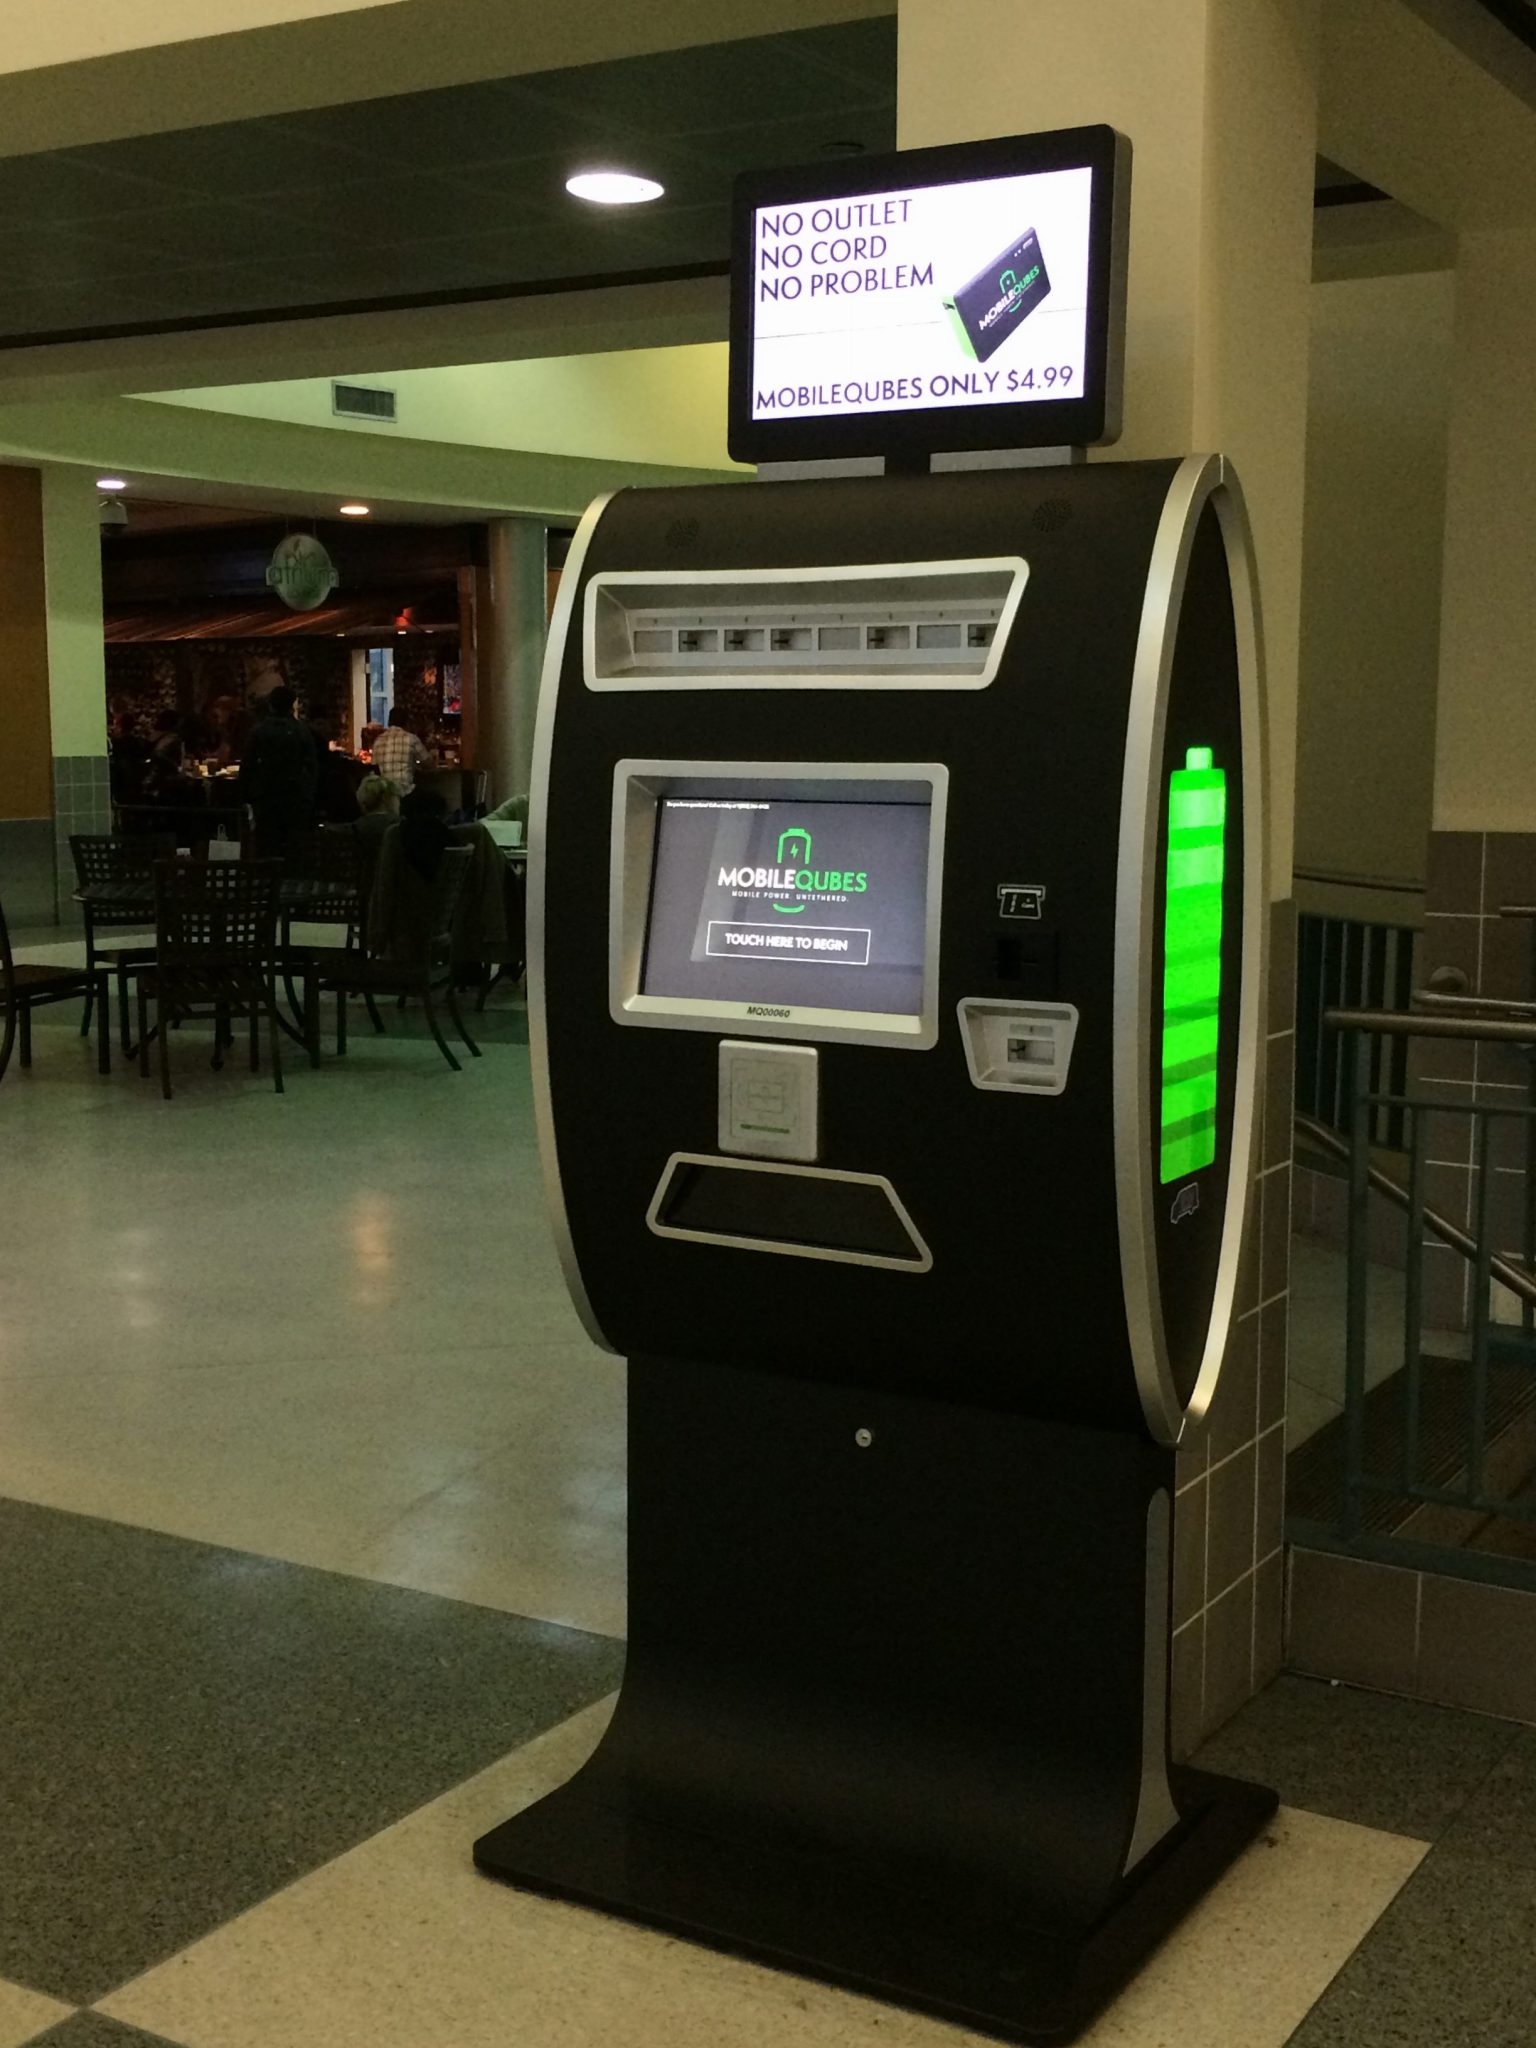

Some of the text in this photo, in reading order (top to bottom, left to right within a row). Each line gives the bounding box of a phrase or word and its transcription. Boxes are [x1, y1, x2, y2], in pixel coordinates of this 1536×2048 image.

[761, 199, 912, 238] NO OUTLET
[761, 235, 887, 270] NO CORD
[761, 262, 934, 302] NO PROBLEM
[978, 265, 1040, 331] MOBILEQUBES
[756, 365, 1074, 410] MOBILEQUBES ONLY $4.99
[717, 866, 868, 893] MOBILEQUBES
[731, 890, 760, 899] MOBILE
[725, 933, 848, 951] TOUCH HERE TO BEGIN
